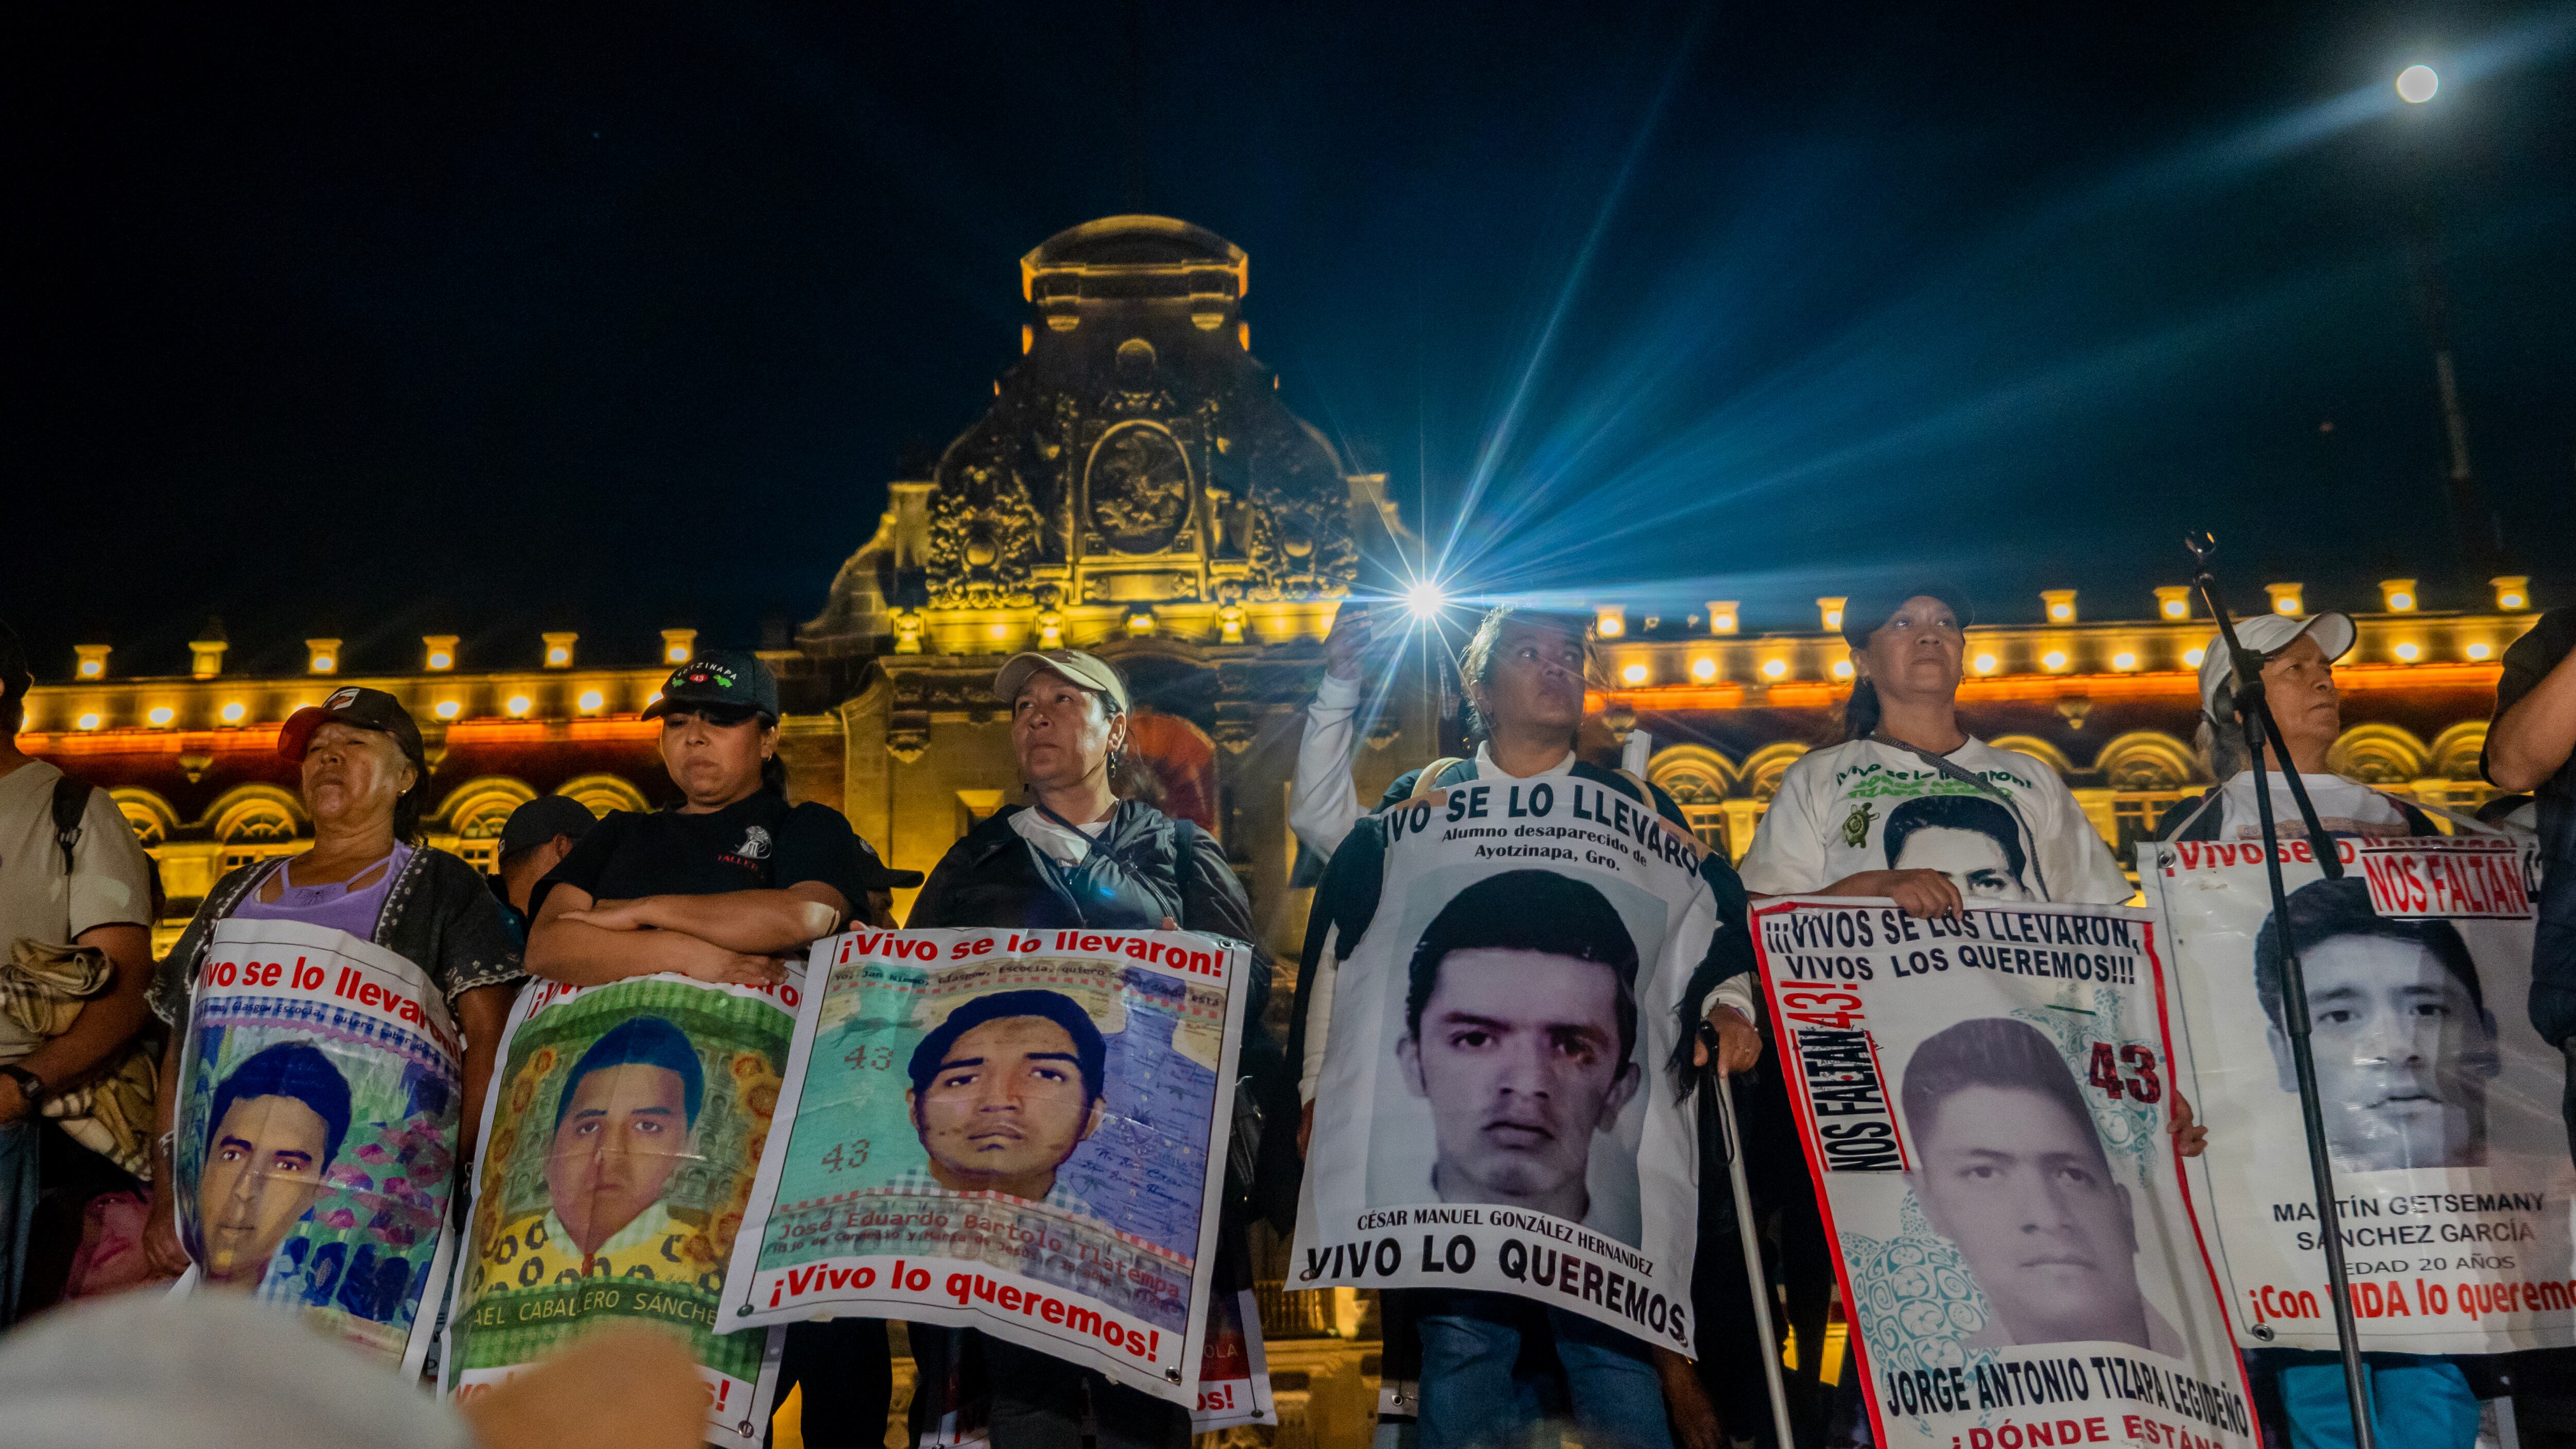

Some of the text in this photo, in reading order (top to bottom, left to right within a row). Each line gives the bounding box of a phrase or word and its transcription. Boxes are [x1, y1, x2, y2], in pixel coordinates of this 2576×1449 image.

[1886, 770, 1909, 780] se
[1446, 786, 1490, 823] SE
[1508, 782, 1554, 817] LO
[1442, 823, 1647, 867] Alumno desaparecido de
[1475, 844, 1620, 871] Ayotzinapa, Gro.
[2362, 855, 2427, 912] NOS
[2426, 855, 2530, 913] FALTAN
[1885, 910, 1920, 944] SE
[1931, 912, 1979, 941] LOS
[1986, 911, 2140, 954] LLEVARON,
[242, 961, 282, 987] se
[291, 956, 325, 991] lo
[839, 931, 1225, 978] ¡Vivo se lo llevaron!
[861, 968, 883, 979] Jan
[1062, 966, 1105, 978] quiero
[1785, 945, 2135, 984] VIVOS LOS QUEREMOS!!!
[843, 1044, 894, 1071] 43
[1780, 981, 1902, 1171] NOS FALTAN 43!
[2090, 1042, 2161, 1104] 43
[821, 1138, 870, 1173] 43
[1357, 1208, 1408, 1231] CÉSAR
[1414, 1209, 1483, 1226] MANUEL
[1489, 1211, 1574, 1243] GONZÁLEZ
[2273, 1192, 2546, 1222] MATÍN GETSEMANY
[847, 1211, 949, 1228] Eduardo
[964, 1215, 1062, 1253] Bartolo
[1078, 1241, 1180, 1298] Tlatempa
[2297, 1219, 2536, 1250] SNCHEZ GARCÍA
[2345, 1253, 2515, 1275] EDAD 20 AÑOS
[1306, 1235, 1687, 1341] VIVO LO QUEREMOS
[2249, 1285, 2321, 1323] ¡Con
[2324, 1281, 2411, 1318] IDA
[2416, 1278, 2448, 1317] lo
[769, 1260, 1159, 1362] ¡Vivo lo queremos!
[1887, 1356, 2249, 1438] JORGE ANTONIO TIZAPA LEGIDEÑO
